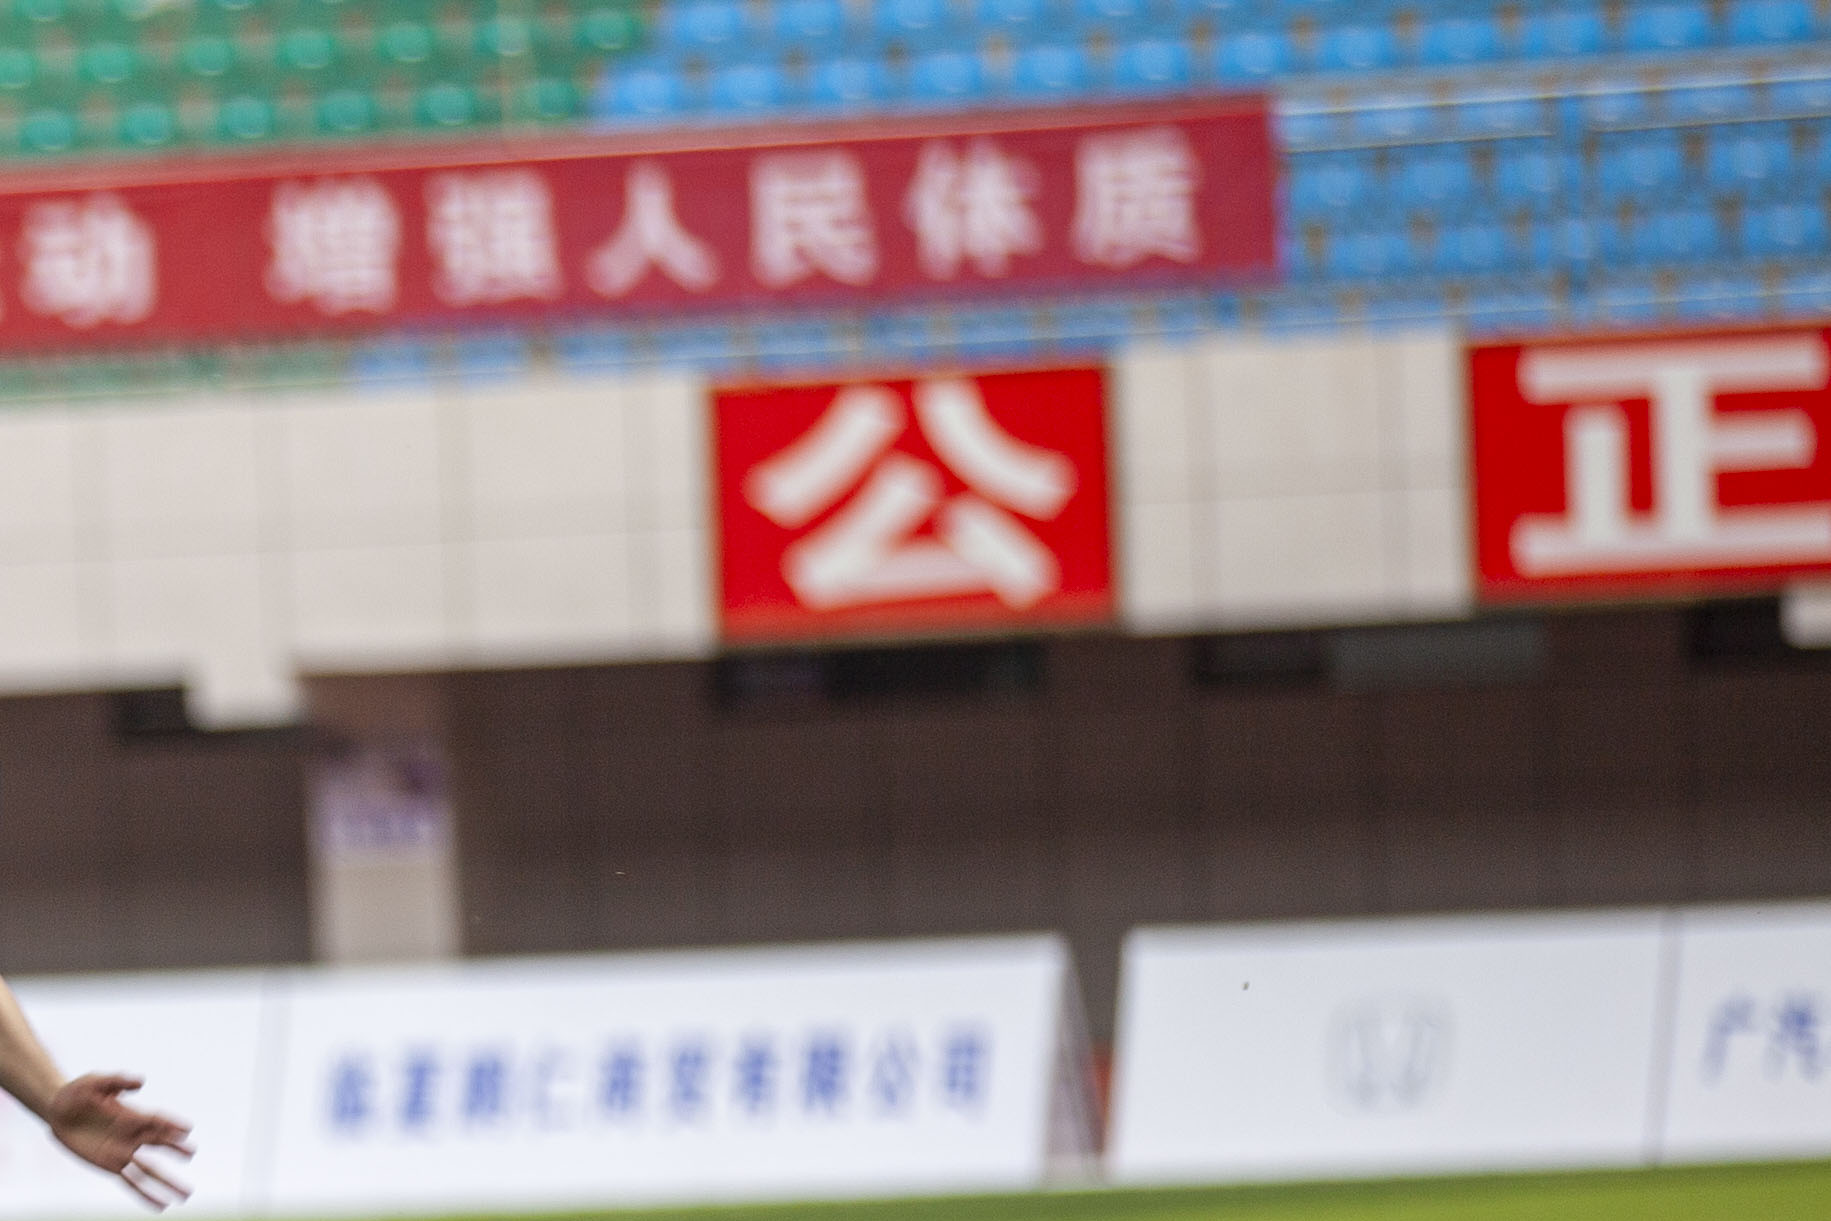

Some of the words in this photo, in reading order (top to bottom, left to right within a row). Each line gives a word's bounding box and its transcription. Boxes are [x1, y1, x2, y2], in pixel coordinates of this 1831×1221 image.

[265, 124, 1201, 314] 增强人民体质
[745, 378, 1076, 609] 公
[1511, 334, 1831, 578] 正
